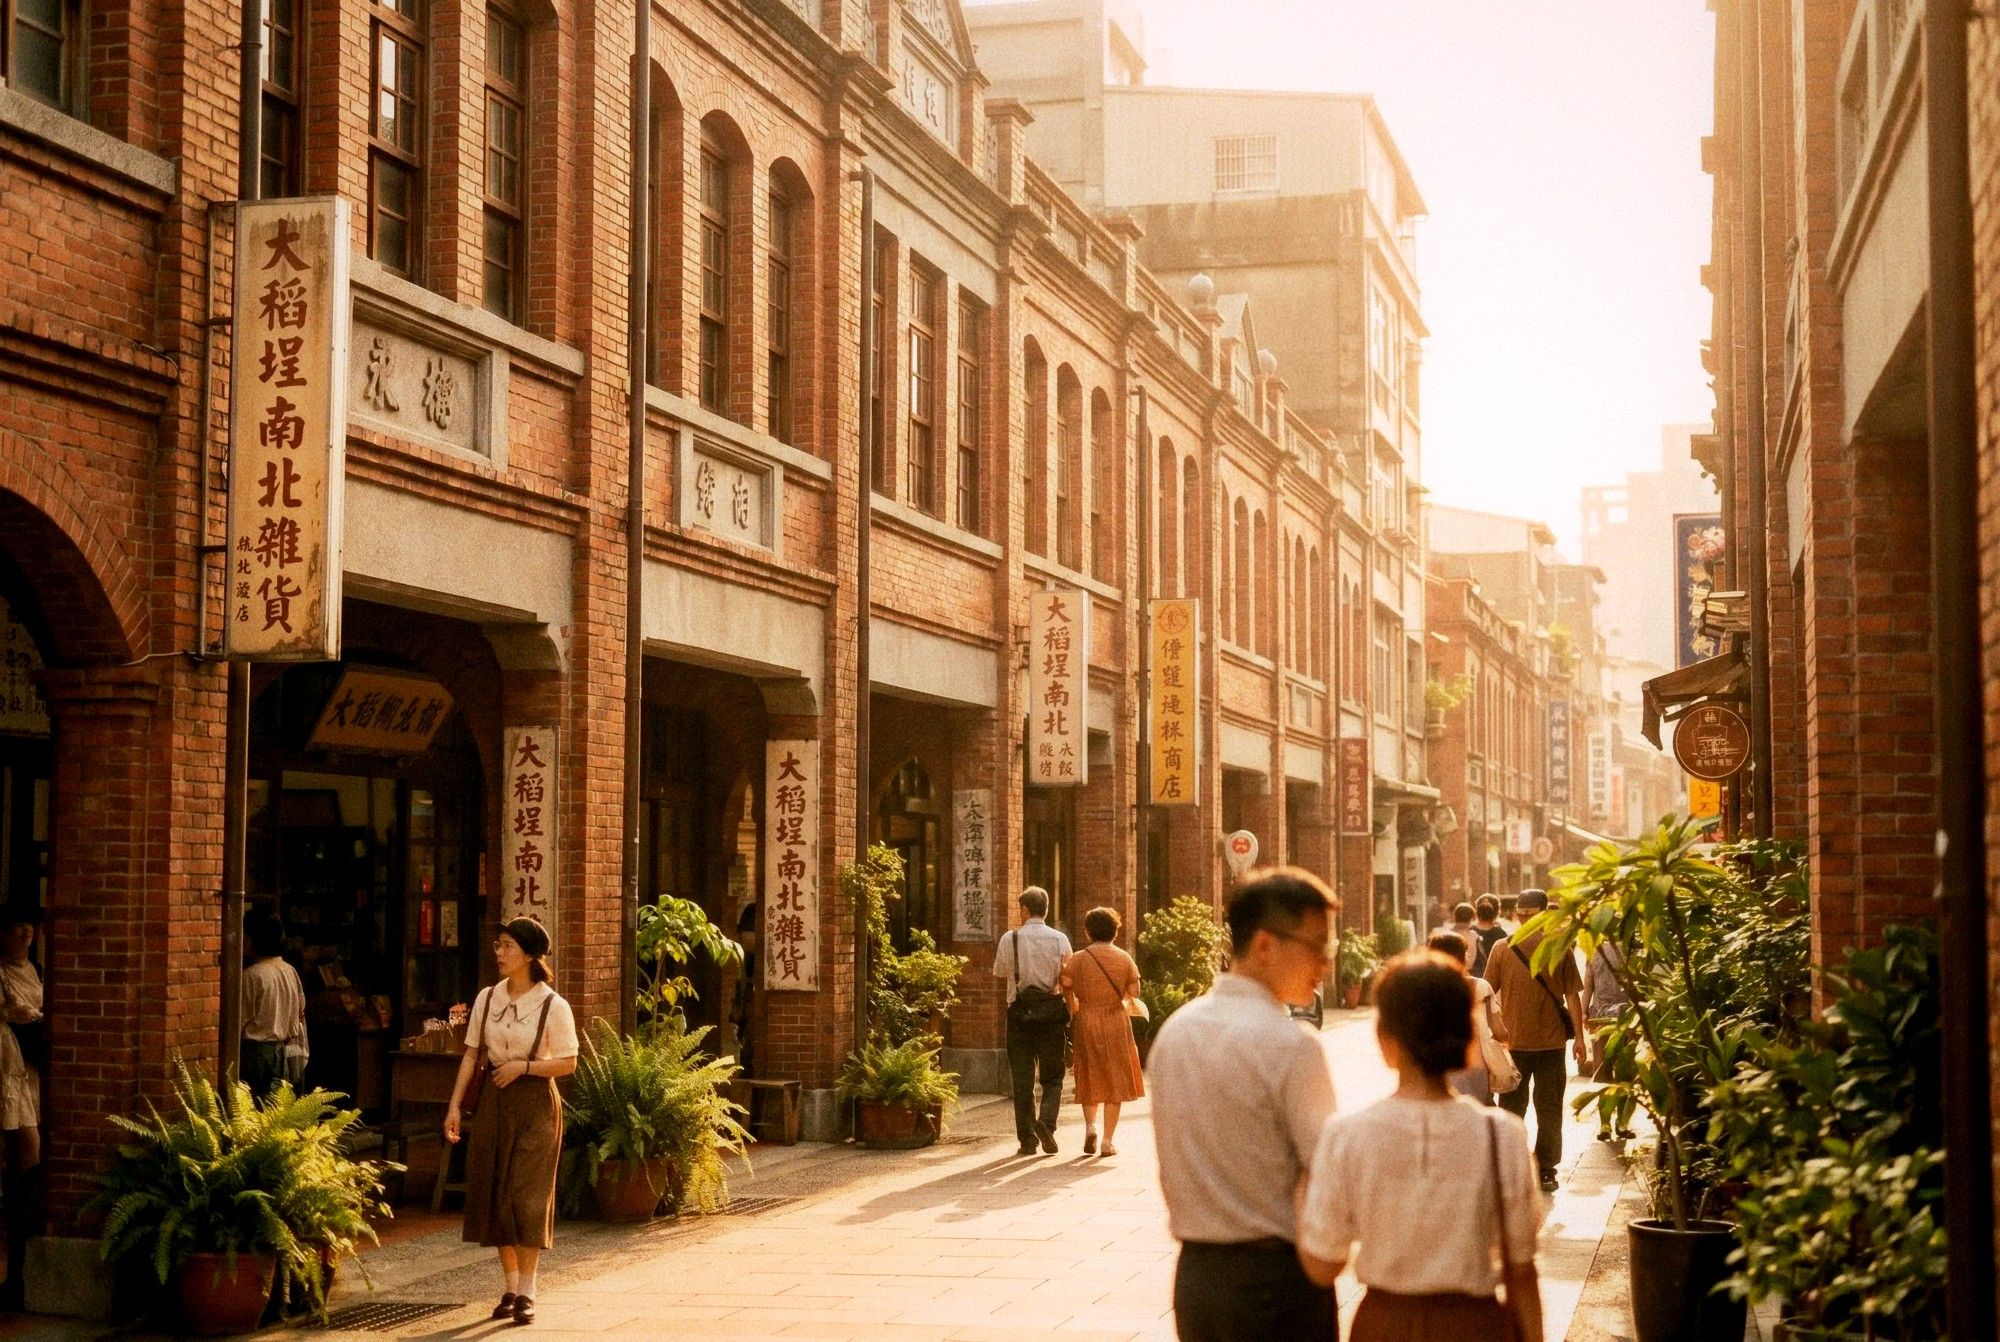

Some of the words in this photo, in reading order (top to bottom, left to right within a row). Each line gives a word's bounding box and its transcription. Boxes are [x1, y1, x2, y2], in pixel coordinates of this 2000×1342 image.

[254, 218, 311, 634] 大稻埕南北雜貨
[1043, 596, 1072, 736] 大稻埕南北
[513, 736, 547, 924] 大稻埕南北
[774, 751, 807, 981] 大稻埕南北雜貨
